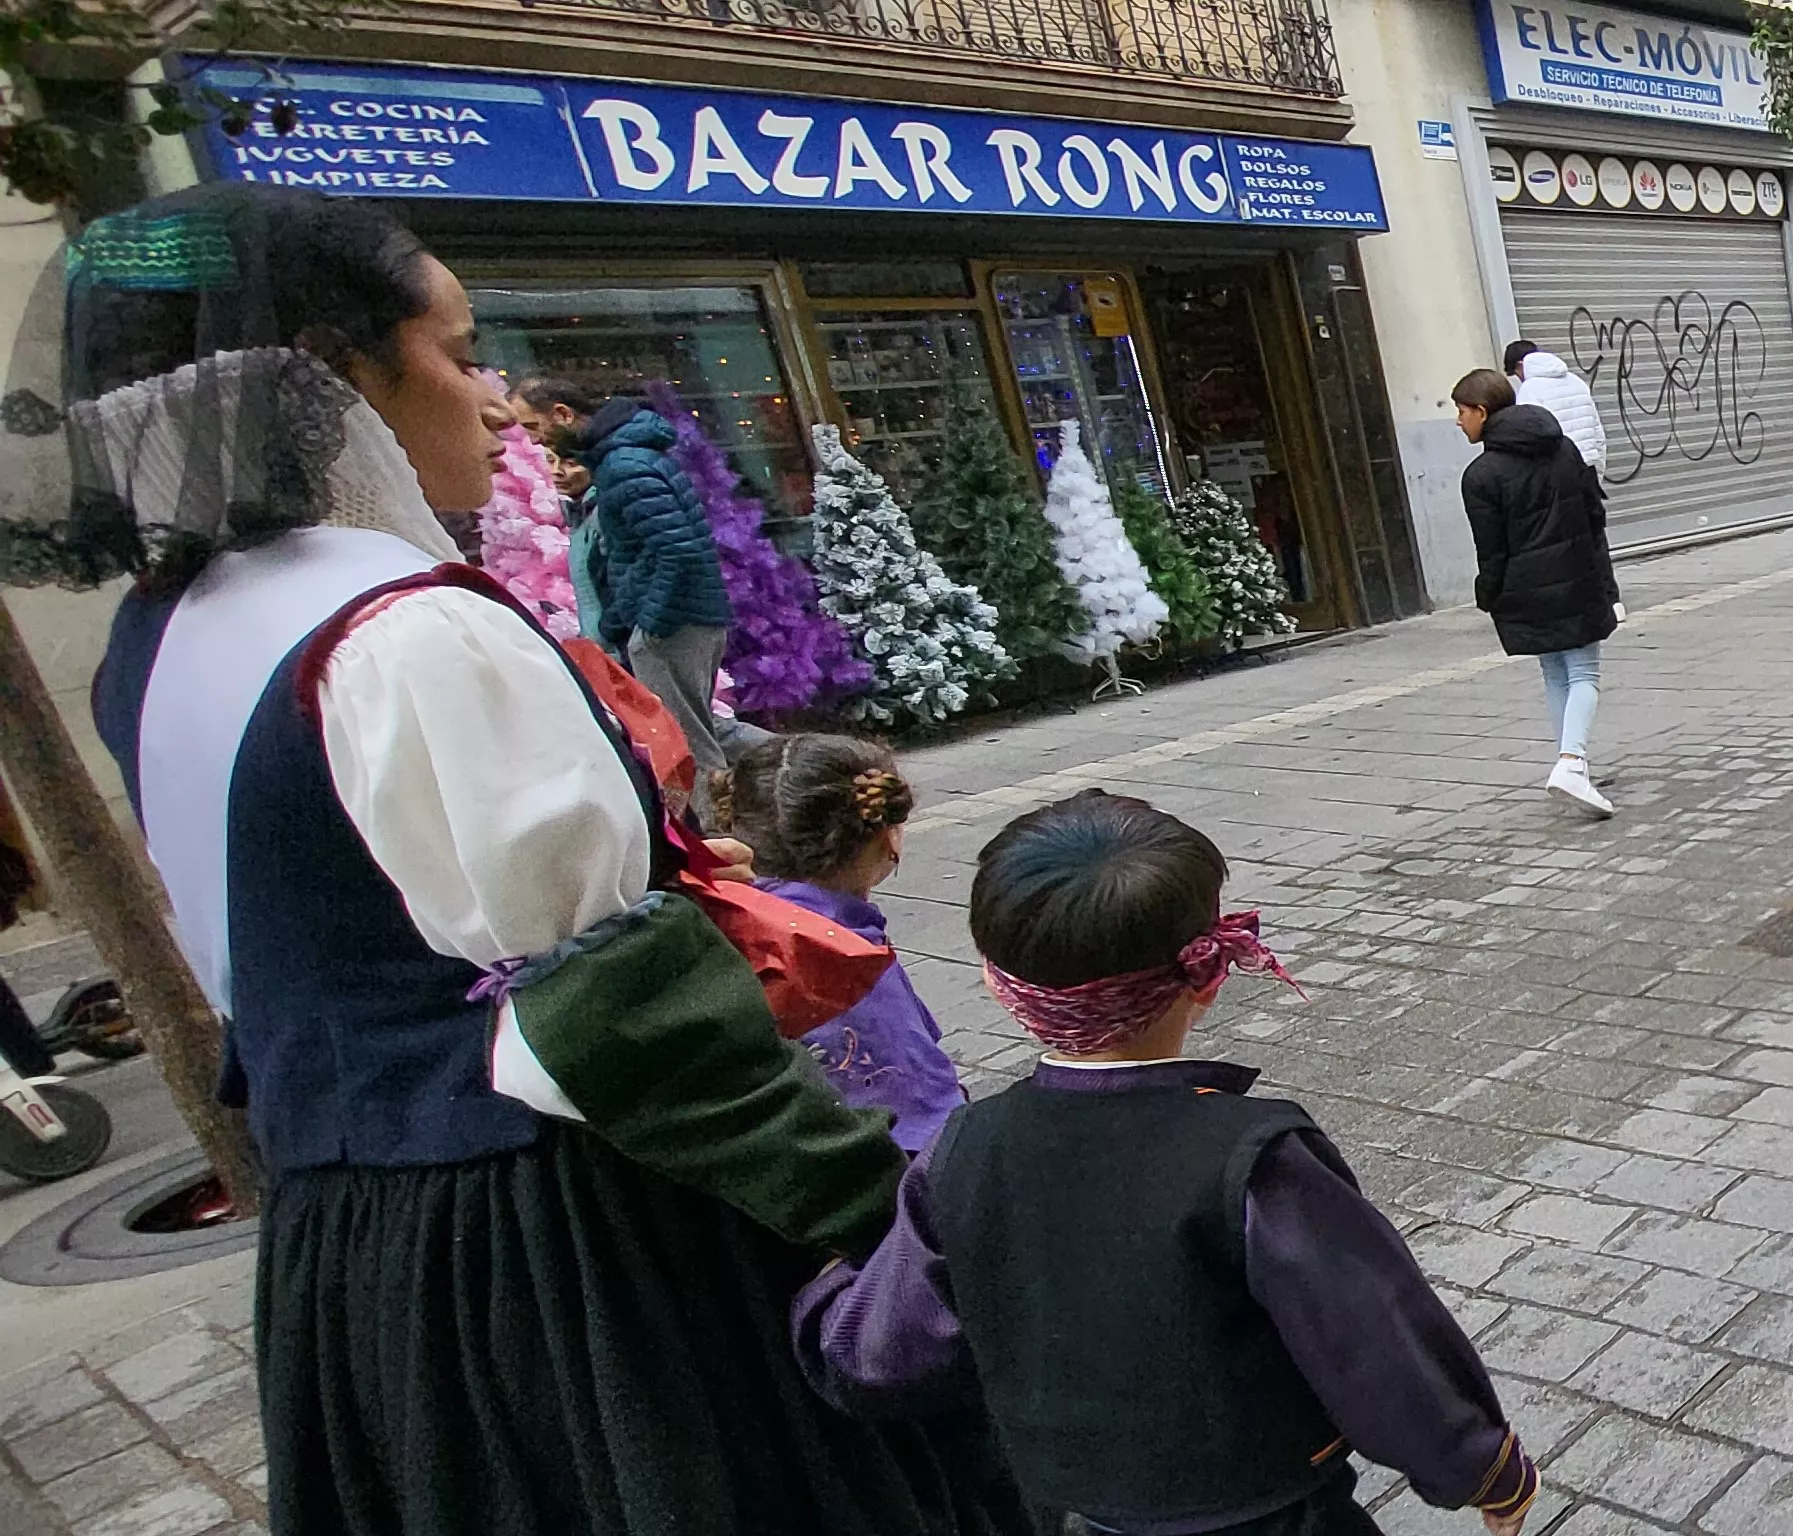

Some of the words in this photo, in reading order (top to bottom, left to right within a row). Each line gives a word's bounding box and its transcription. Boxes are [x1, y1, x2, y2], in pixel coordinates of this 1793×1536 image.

[1547, 66, 1600, 86] SERVICIO
[1650, 82, 1665, 96] DE
[329, 101, 488, 123] COCINA
[1593, 94, 1662, 114] Reparaciones
[1671, 104, 1720, 121] Accesorios
[238, 121, 490, 146] ERRETERÍA
[582, 99, 973, 203] BAZAR
[986, 129, 1229, 213] RONG
[1236, 144, 1287, 159] ROPA
[1239, 160, 1312, 176] BOLSOS
[1243, 176, 1326, 192] REGALOS
[1761, 181, 1777, 198] ZTE
[1247, 191, 1316, 206] FLORES
[1251, 207, 1298, 220] MAT.
[1301, 209, 1378, 223] ESCOLAR
